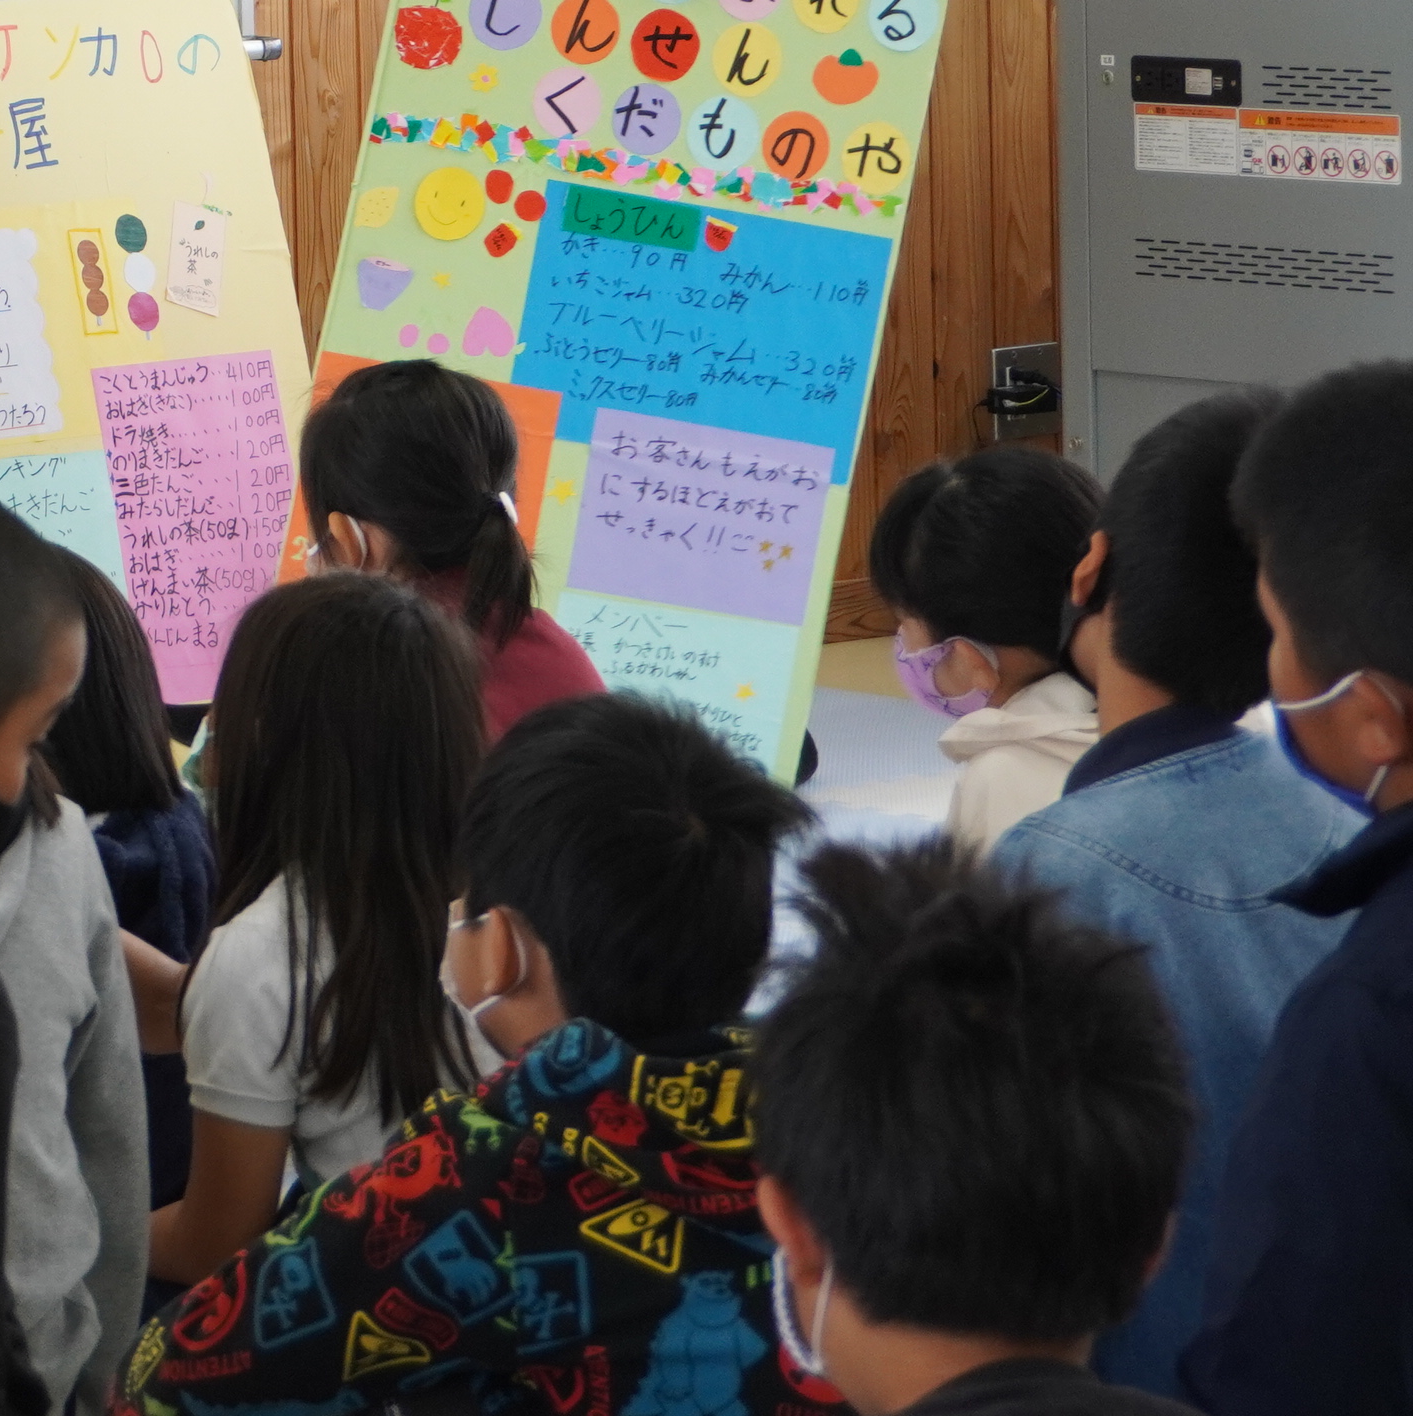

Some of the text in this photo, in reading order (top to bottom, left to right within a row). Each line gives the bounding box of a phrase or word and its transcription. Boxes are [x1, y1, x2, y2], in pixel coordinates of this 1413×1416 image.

[544, 75, 902, 179] くだものや
[572, 193, 684, 240] しょうひん
[187, 259, 197, 275] 茶
[561, 233, 688, 271] かき 90円
[720, 262, 790, 294] みかん
[99, 363, 208, 395] こくとうまんじゅう
[111, 422, 169, 450] ドラ焼き
[129, 548, 180, 575] おはぎ
[585, 605, 688, 637] メンバー
